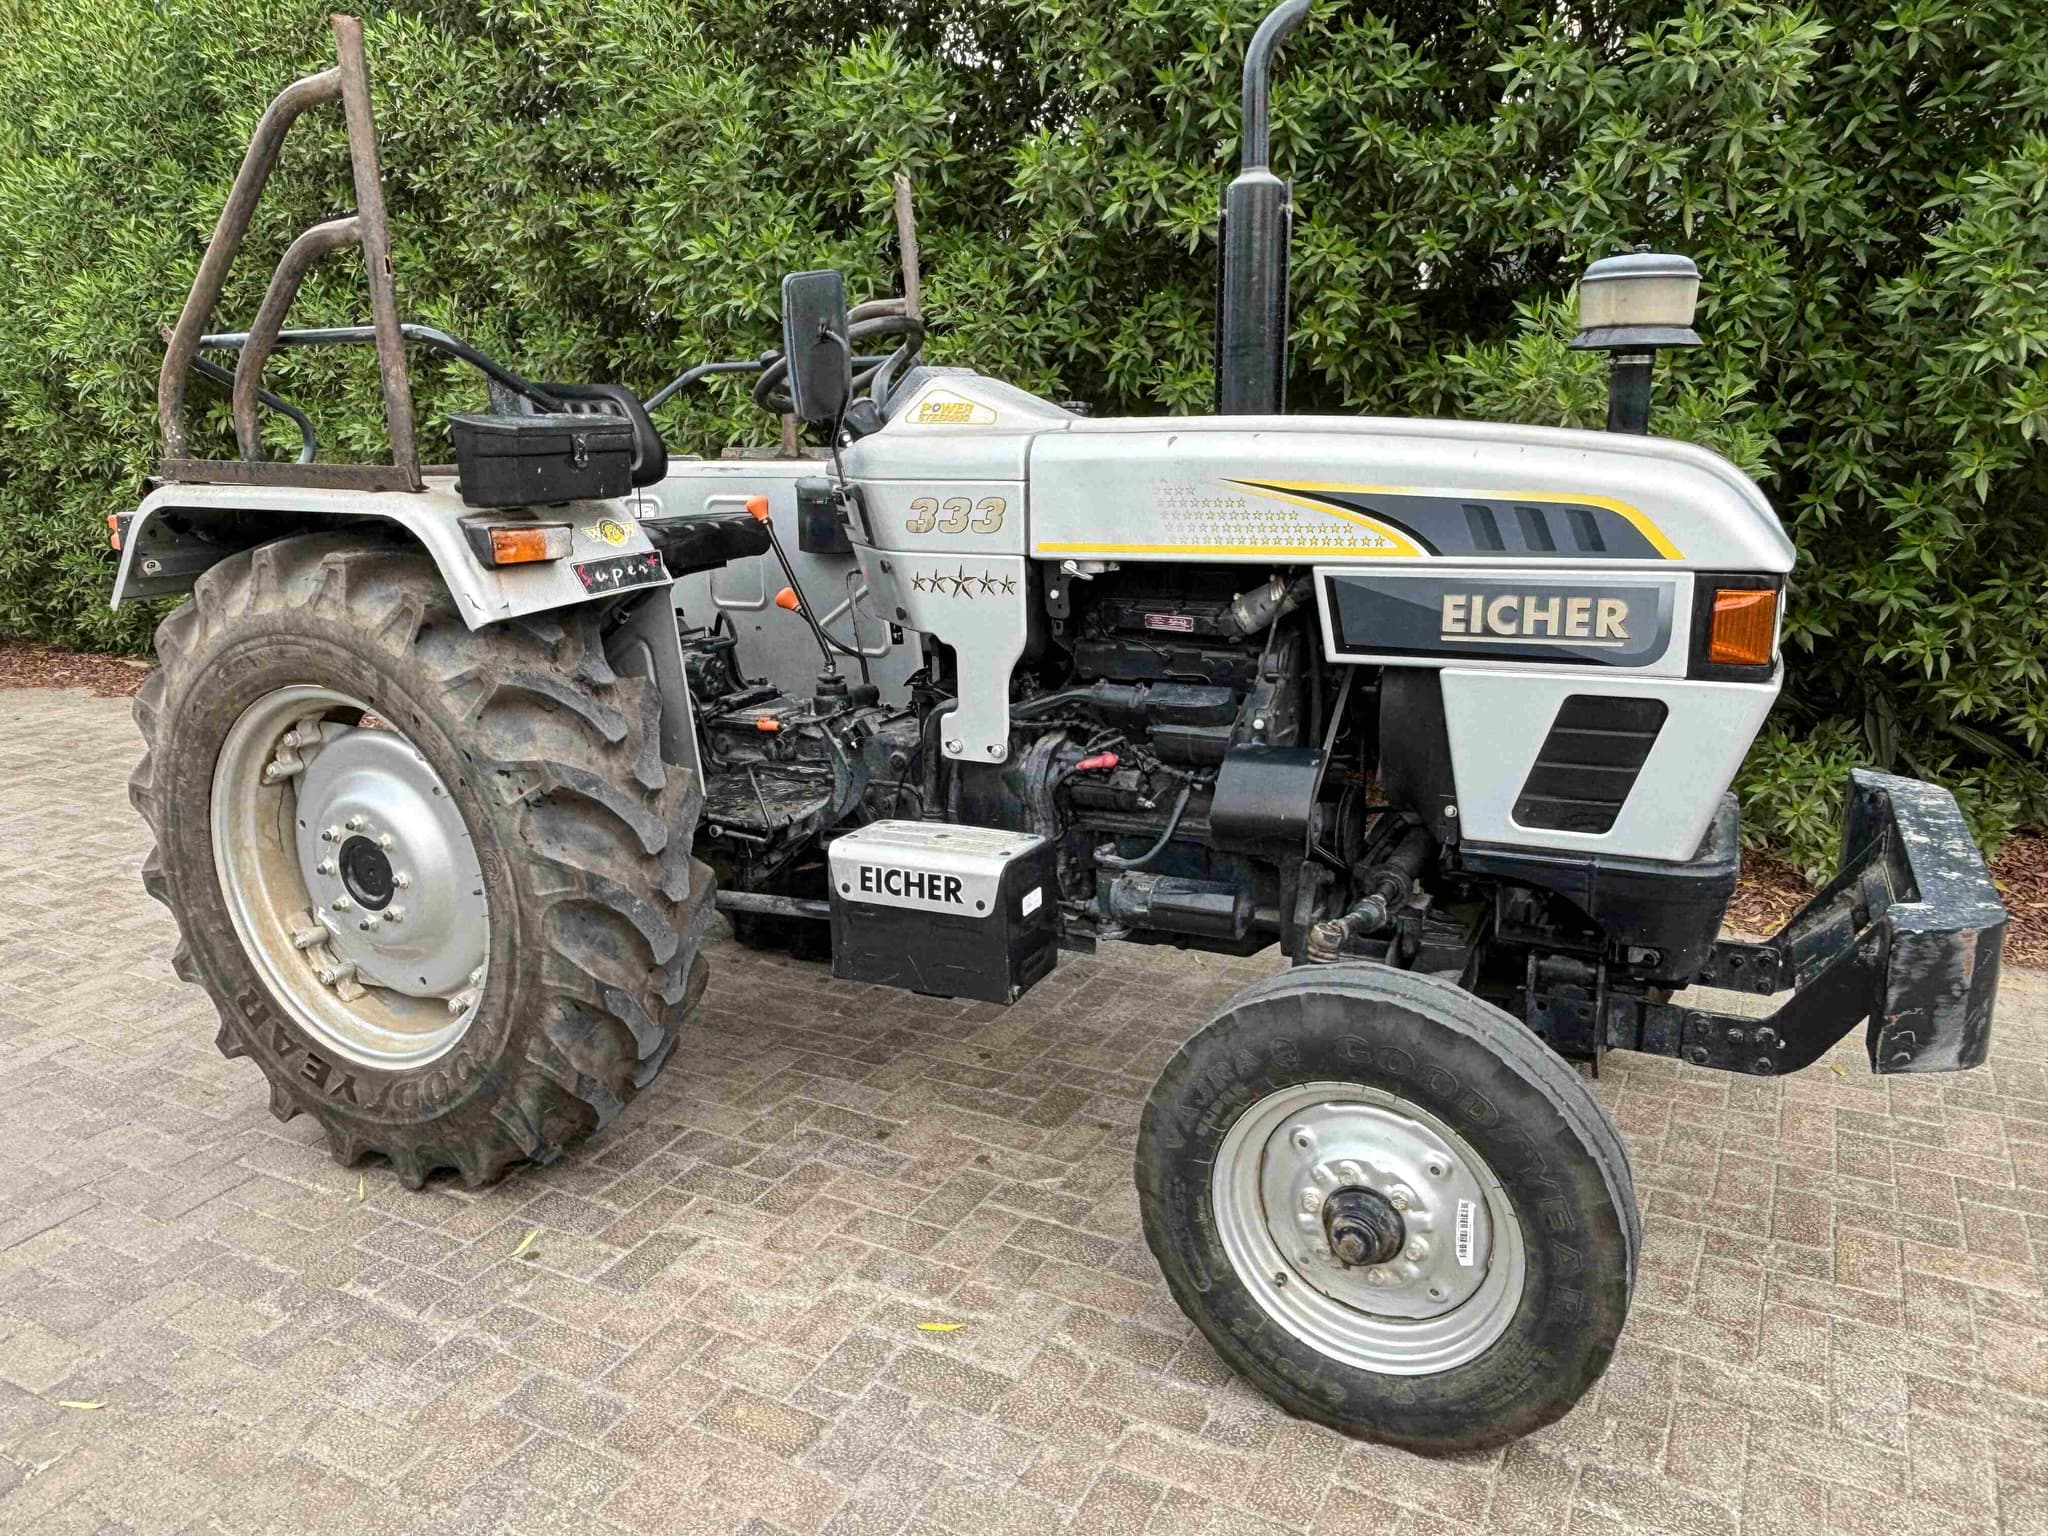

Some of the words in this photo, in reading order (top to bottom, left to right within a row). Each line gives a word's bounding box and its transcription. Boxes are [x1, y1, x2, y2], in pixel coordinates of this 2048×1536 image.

[920, 402, 975, 414] POWER
[905, 497, 1007, 534] 333
[1441, 594, 1630, 639] EICHER
[859, 865, 964, 905] EICHER
[237, 988, 360, 1105] YEAR
[1335, 1033, 1500, 1129] GOOD
